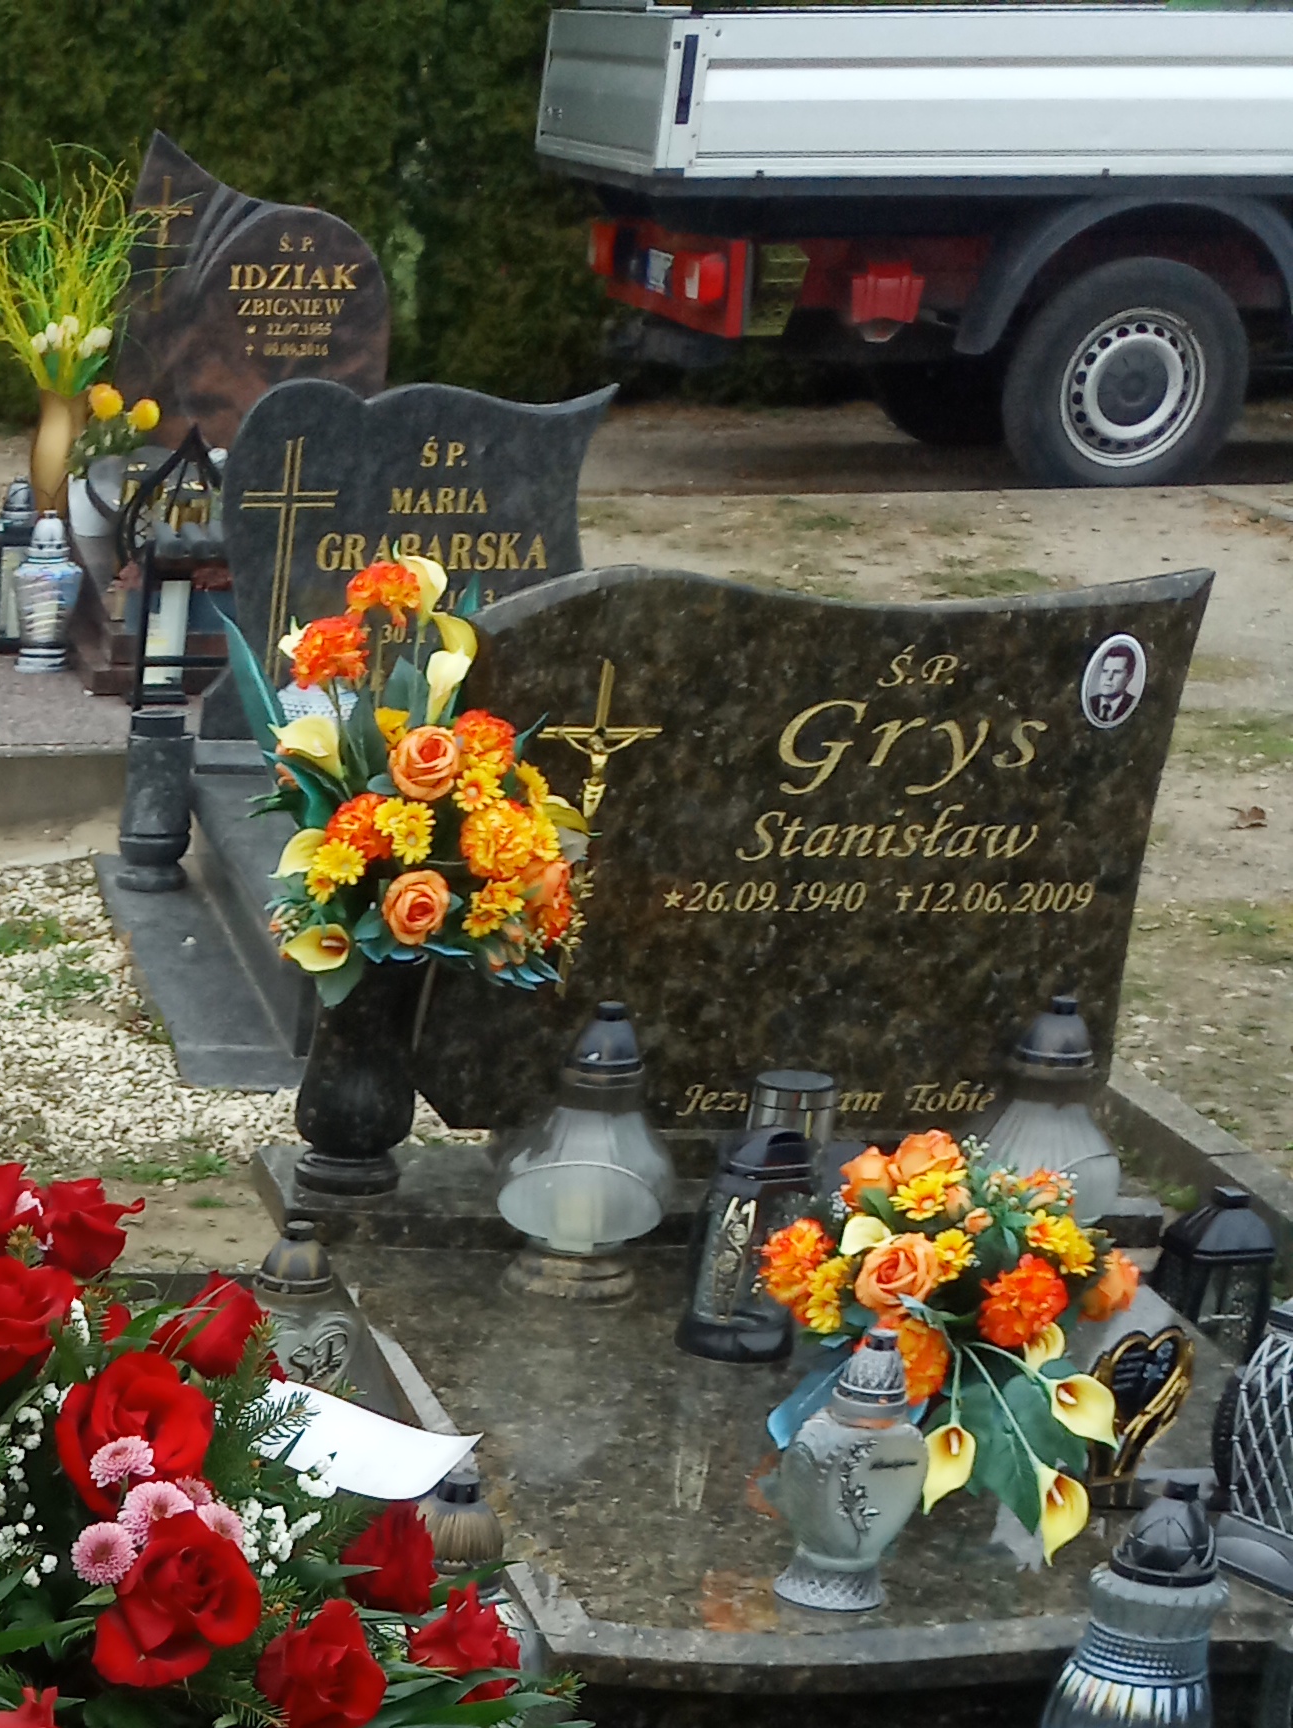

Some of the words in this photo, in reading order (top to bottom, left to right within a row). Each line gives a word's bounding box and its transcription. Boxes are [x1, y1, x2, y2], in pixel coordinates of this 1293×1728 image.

[228, 263, 360, 290] IDZIAK
[237, 298, 345, 316] ZBIGNIEW
[388, 487, 488, 514] MARIA
[778, 699, 1048, 796] Grys
[735, 803, 1039, 862] Stanisław
[684, 881, 867, 912] 26.09.1940
[912, 881, 1095, 912] 12.06.2009
